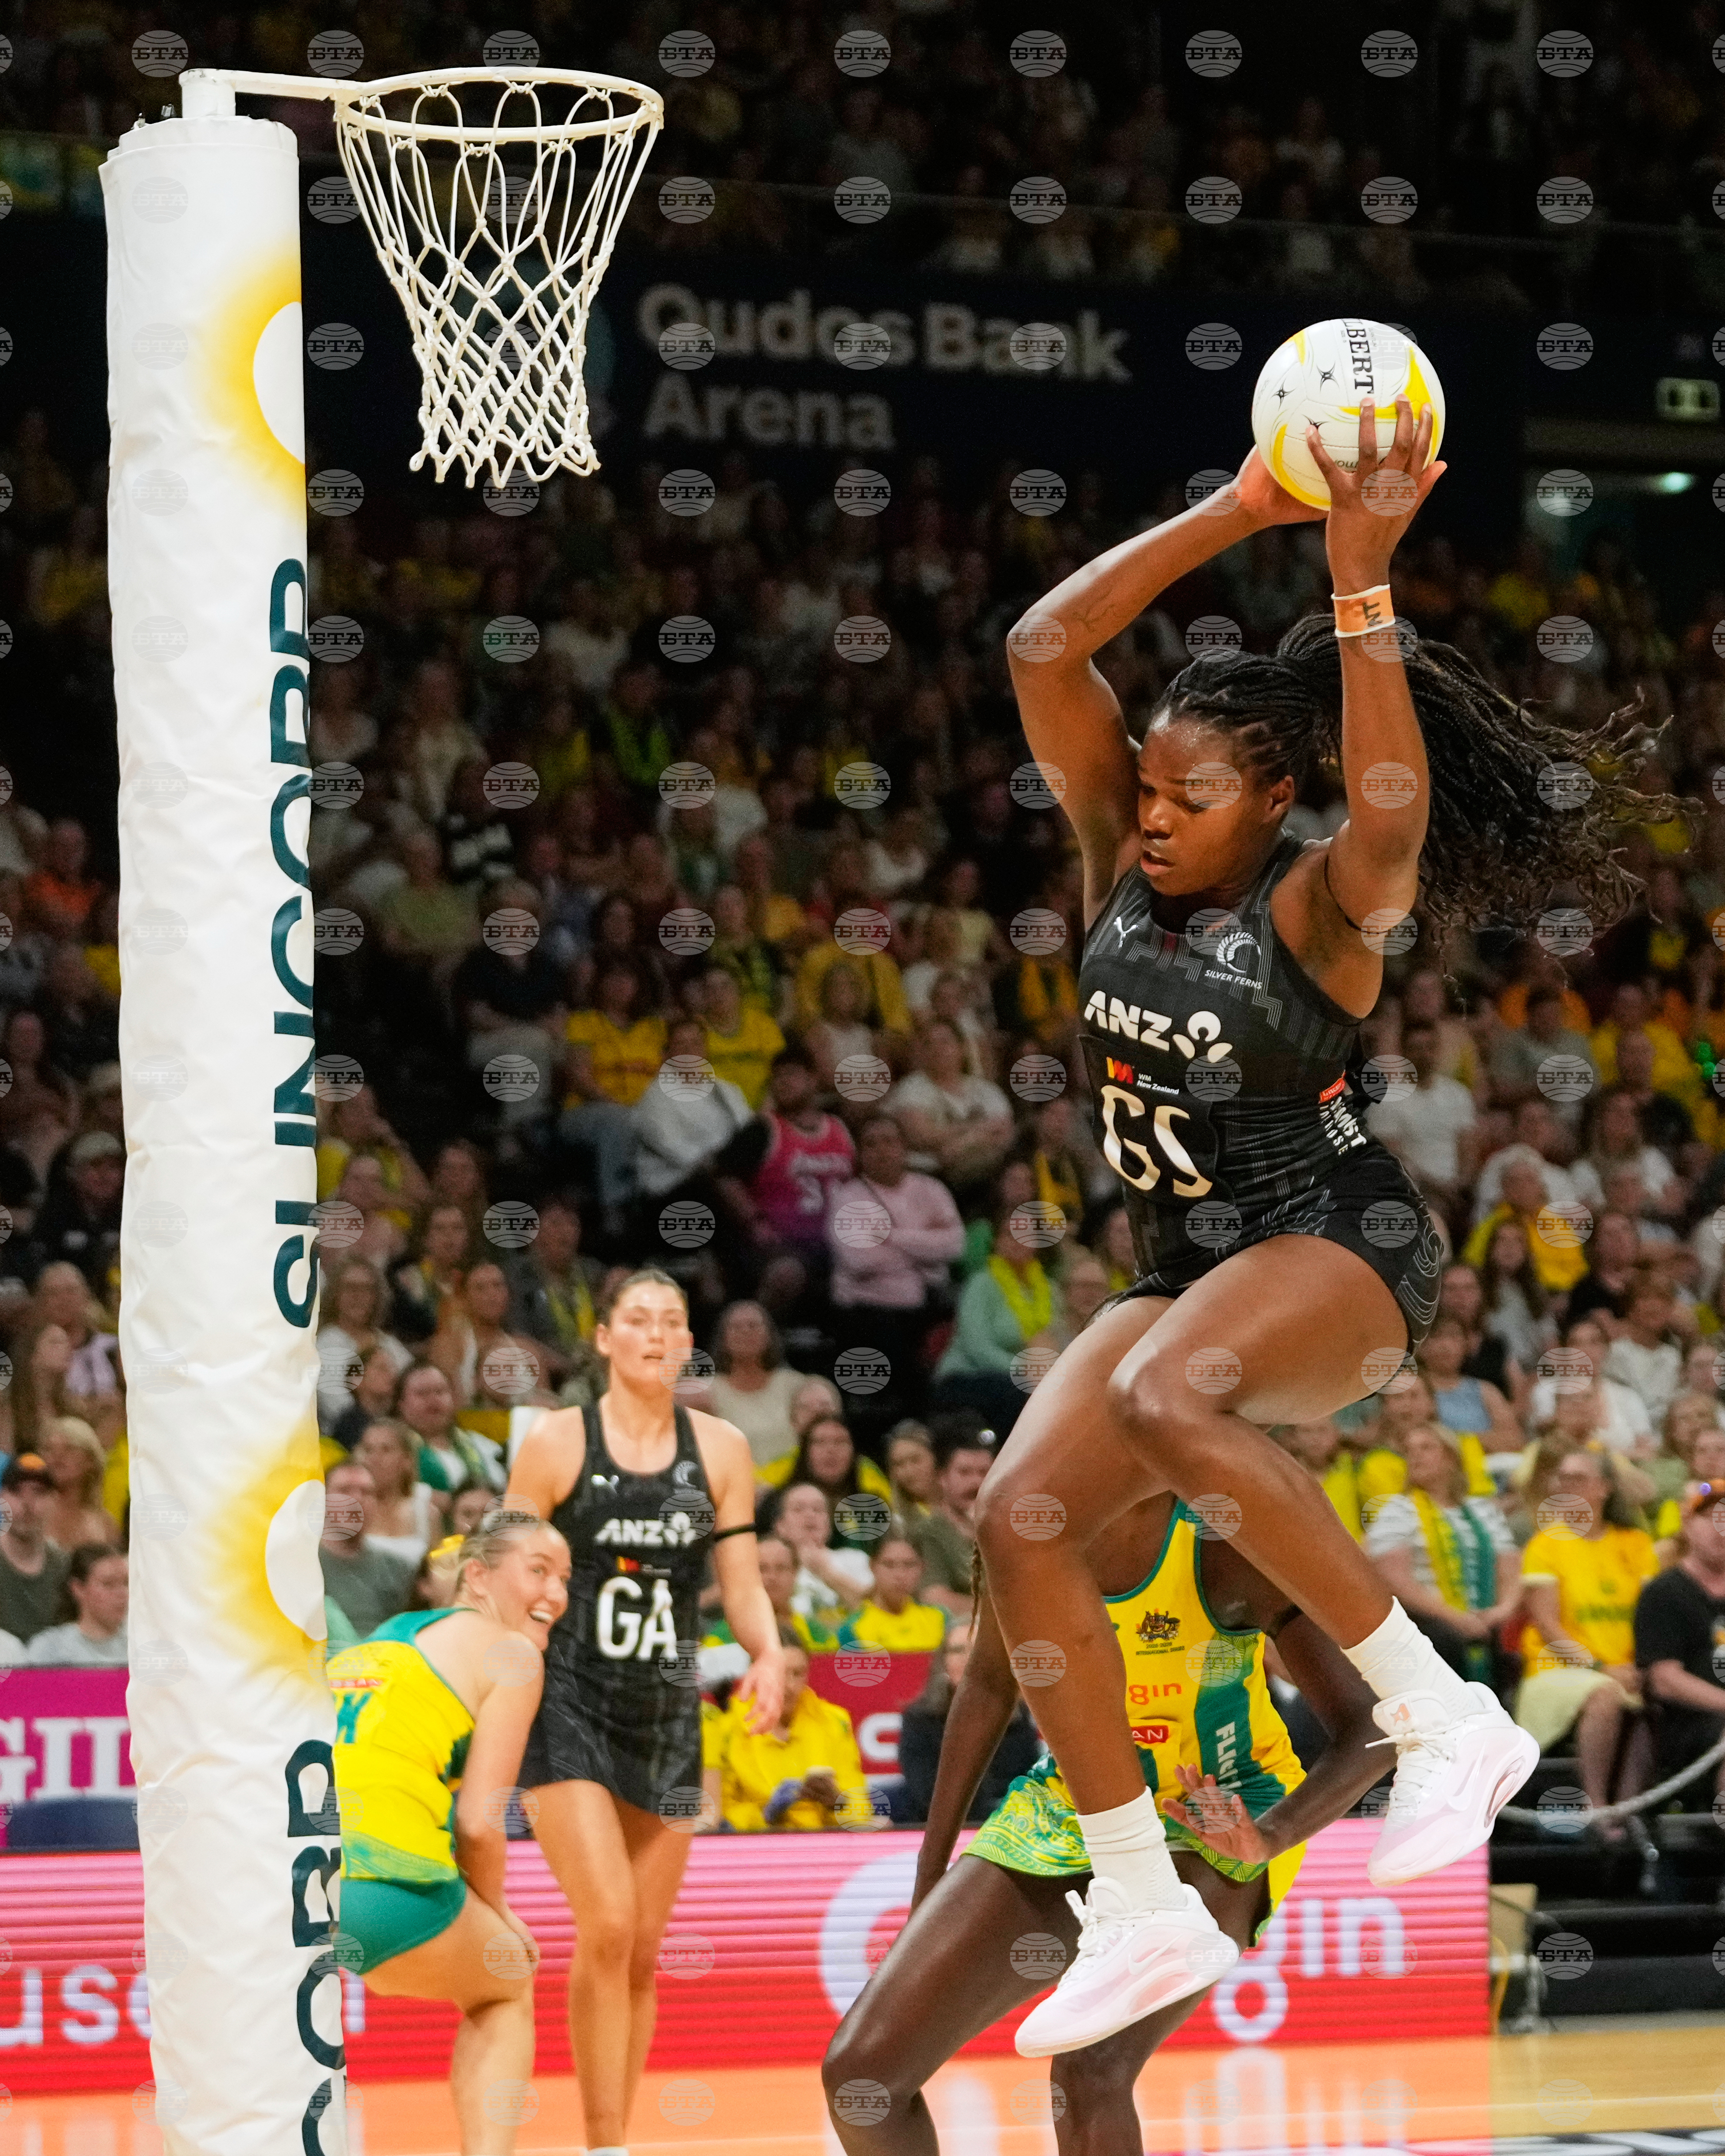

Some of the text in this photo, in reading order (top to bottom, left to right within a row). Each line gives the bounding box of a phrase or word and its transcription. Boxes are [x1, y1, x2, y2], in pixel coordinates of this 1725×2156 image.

[638, 283, 1132, 383] Qudos Bank
[1342, 319, 1374, 394] LBERT
[644, 372, 896, 450] Arena
[270, 559, 321, 1328] SUNCORP
[1204, 970, 1263, 989] SILVER FERNS
[1084, 990, 1172, 1051] ANZ
[1137, 1080, 1180, 1095] New Zealand
[1138, 1073, 1152, 1082] WM
[1101, 1084, 1213, 1198] GS
[595, 1518, 664, 1546] ANZ
[597, 1576, 679, 1661] GA
[1128, 1683, 1183, 1705] gin
[285, 1739, 347, 2156] CORP
[1213, 1897, 1404, 2041] gin
